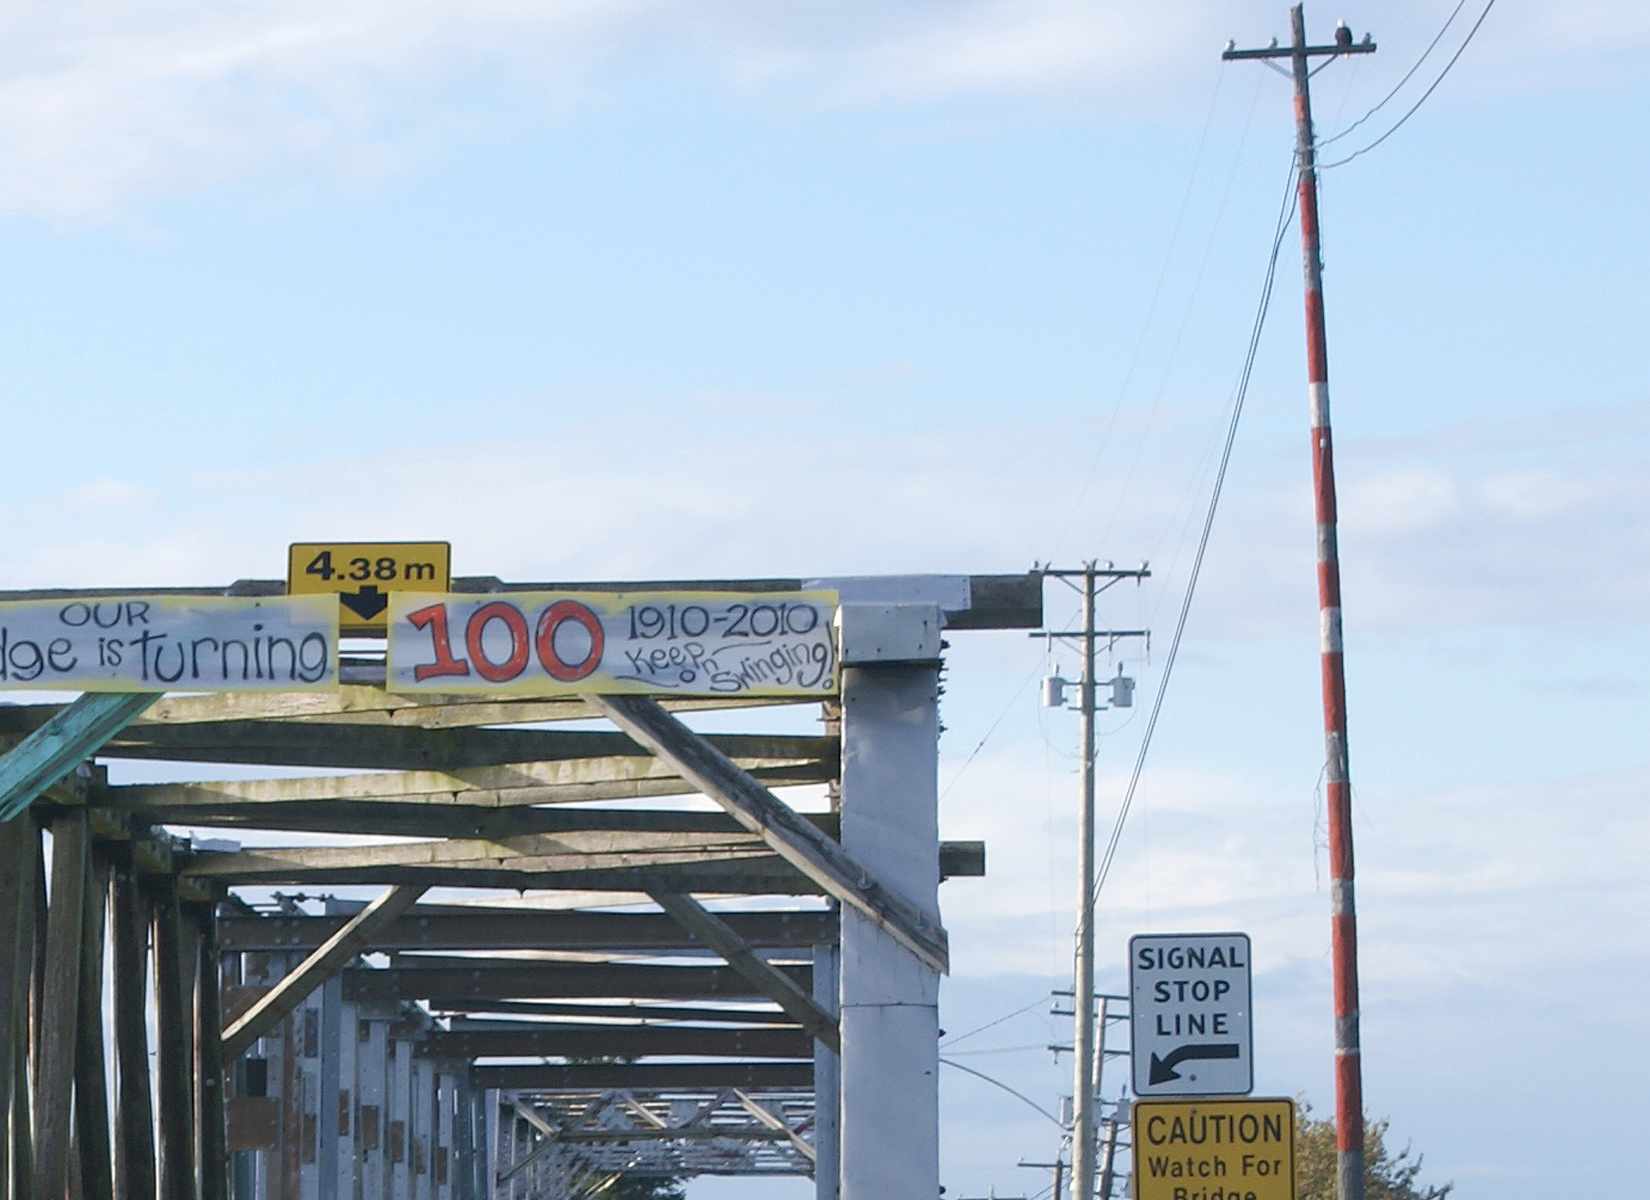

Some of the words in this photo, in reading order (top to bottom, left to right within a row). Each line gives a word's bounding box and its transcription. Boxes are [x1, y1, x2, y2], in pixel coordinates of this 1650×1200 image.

[305, 550, 396, 582] 4.38
[403, 562, 436, 581] m
[59, 602, 151, 628] OUR
[628, 603, 818, 640] 1910-2010
[98, 637, 122, 667] is
[129, 624, 328, 682] turning
[406, 600, 604, 682] 100
[1138, 947, 1245, 970] SIGNAL
[1154, 980, 1230, 1003] STOP
[1156, 1013, 1229, 1036] LINE
[1147, 1114, 1282, 1145] CAUTION
[1148, 1156, 1227, 1178] Watch
[1242, 1155, 1281, 1177] For
